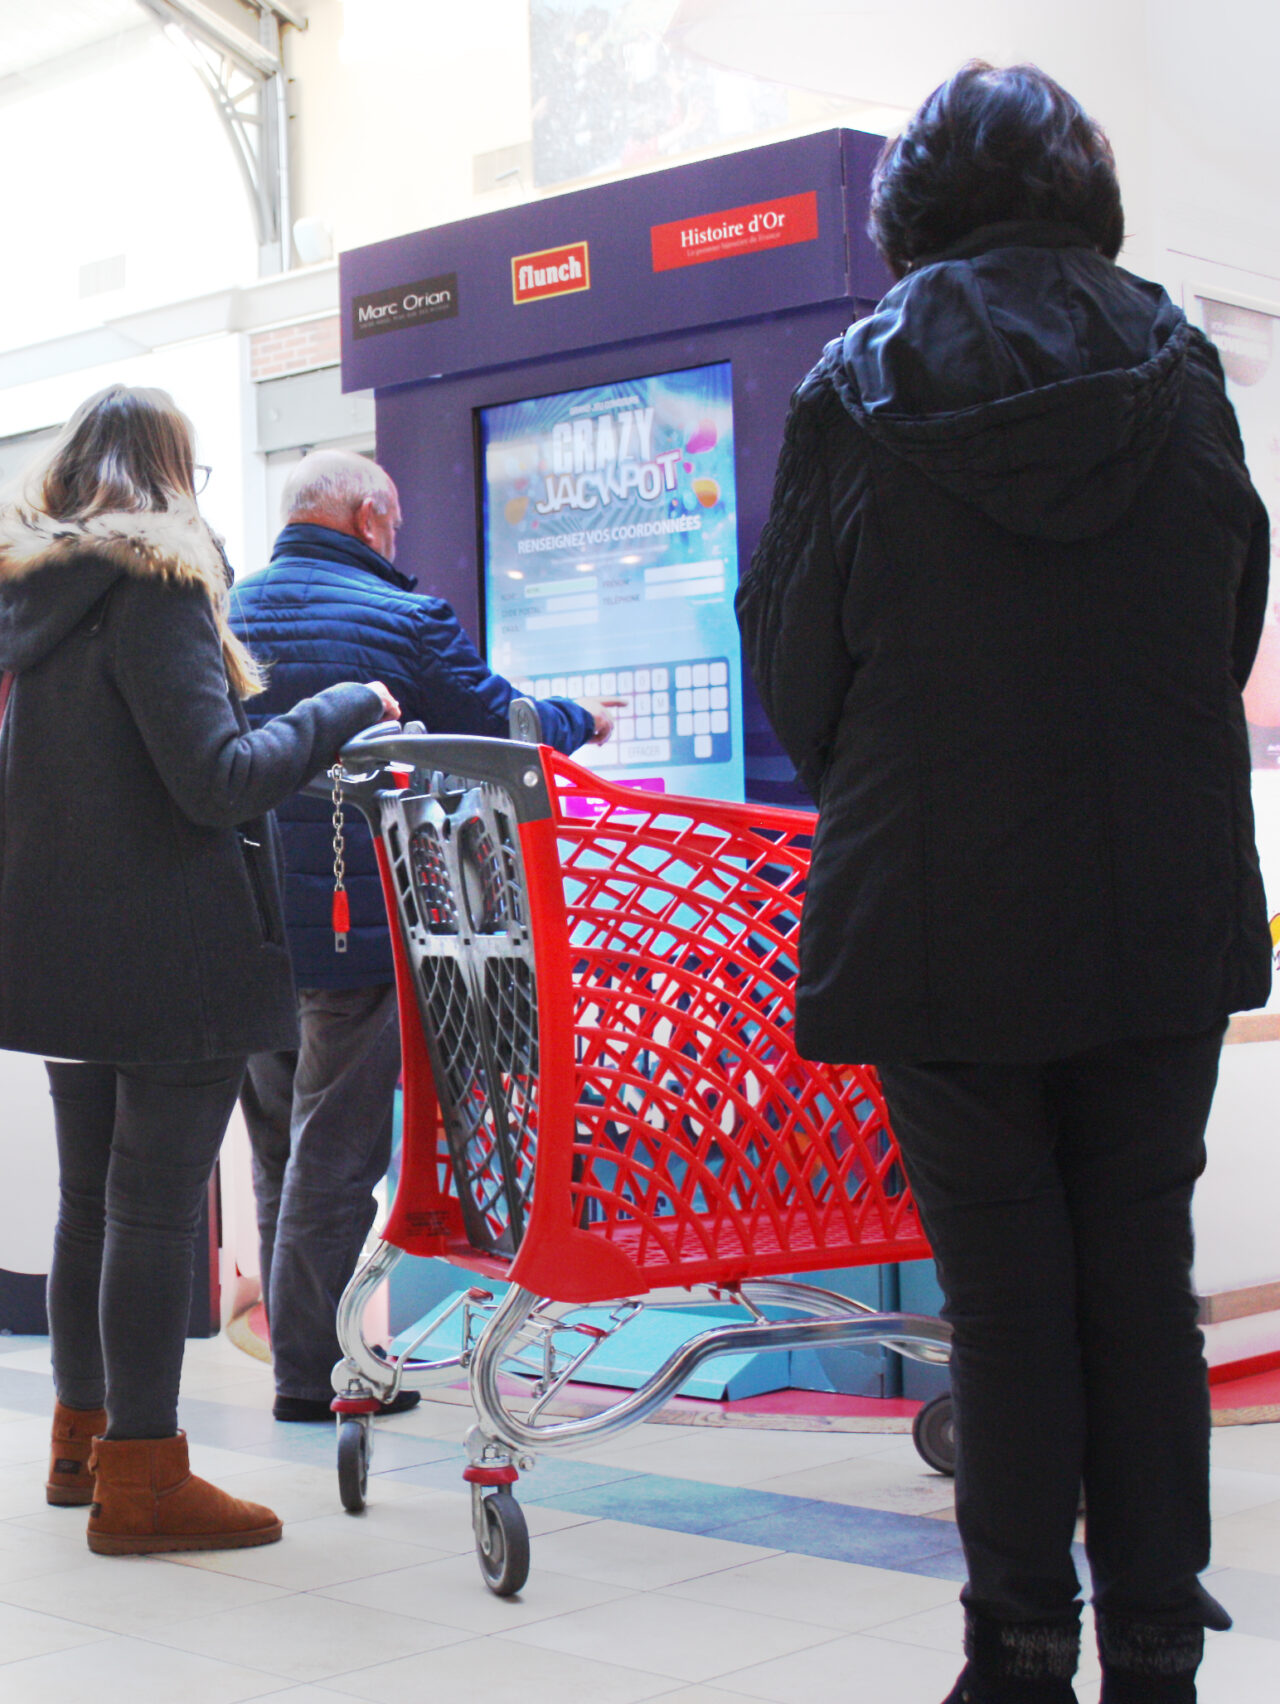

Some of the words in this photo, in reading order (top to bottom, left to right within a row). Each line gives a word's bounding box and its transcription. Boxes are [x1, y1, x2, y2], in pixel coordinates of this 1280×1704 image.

[680, 222, 744, 248] Histoire
[748, 211, 786, 233] d'Or
[518, 255, 583, 291] flunch
[358, 303, 398, 323] Marc
[402, 291, 451, 311] Orian
[552, 407, 655, 475] CRAZY
[535, 448, 683, 515] JACKPOT
[517, 532, 586, 555] RENSEIGNEZ
[585, 528, 610, 545] VOS
[611, 514, 702, 543] COORDONNÉES
